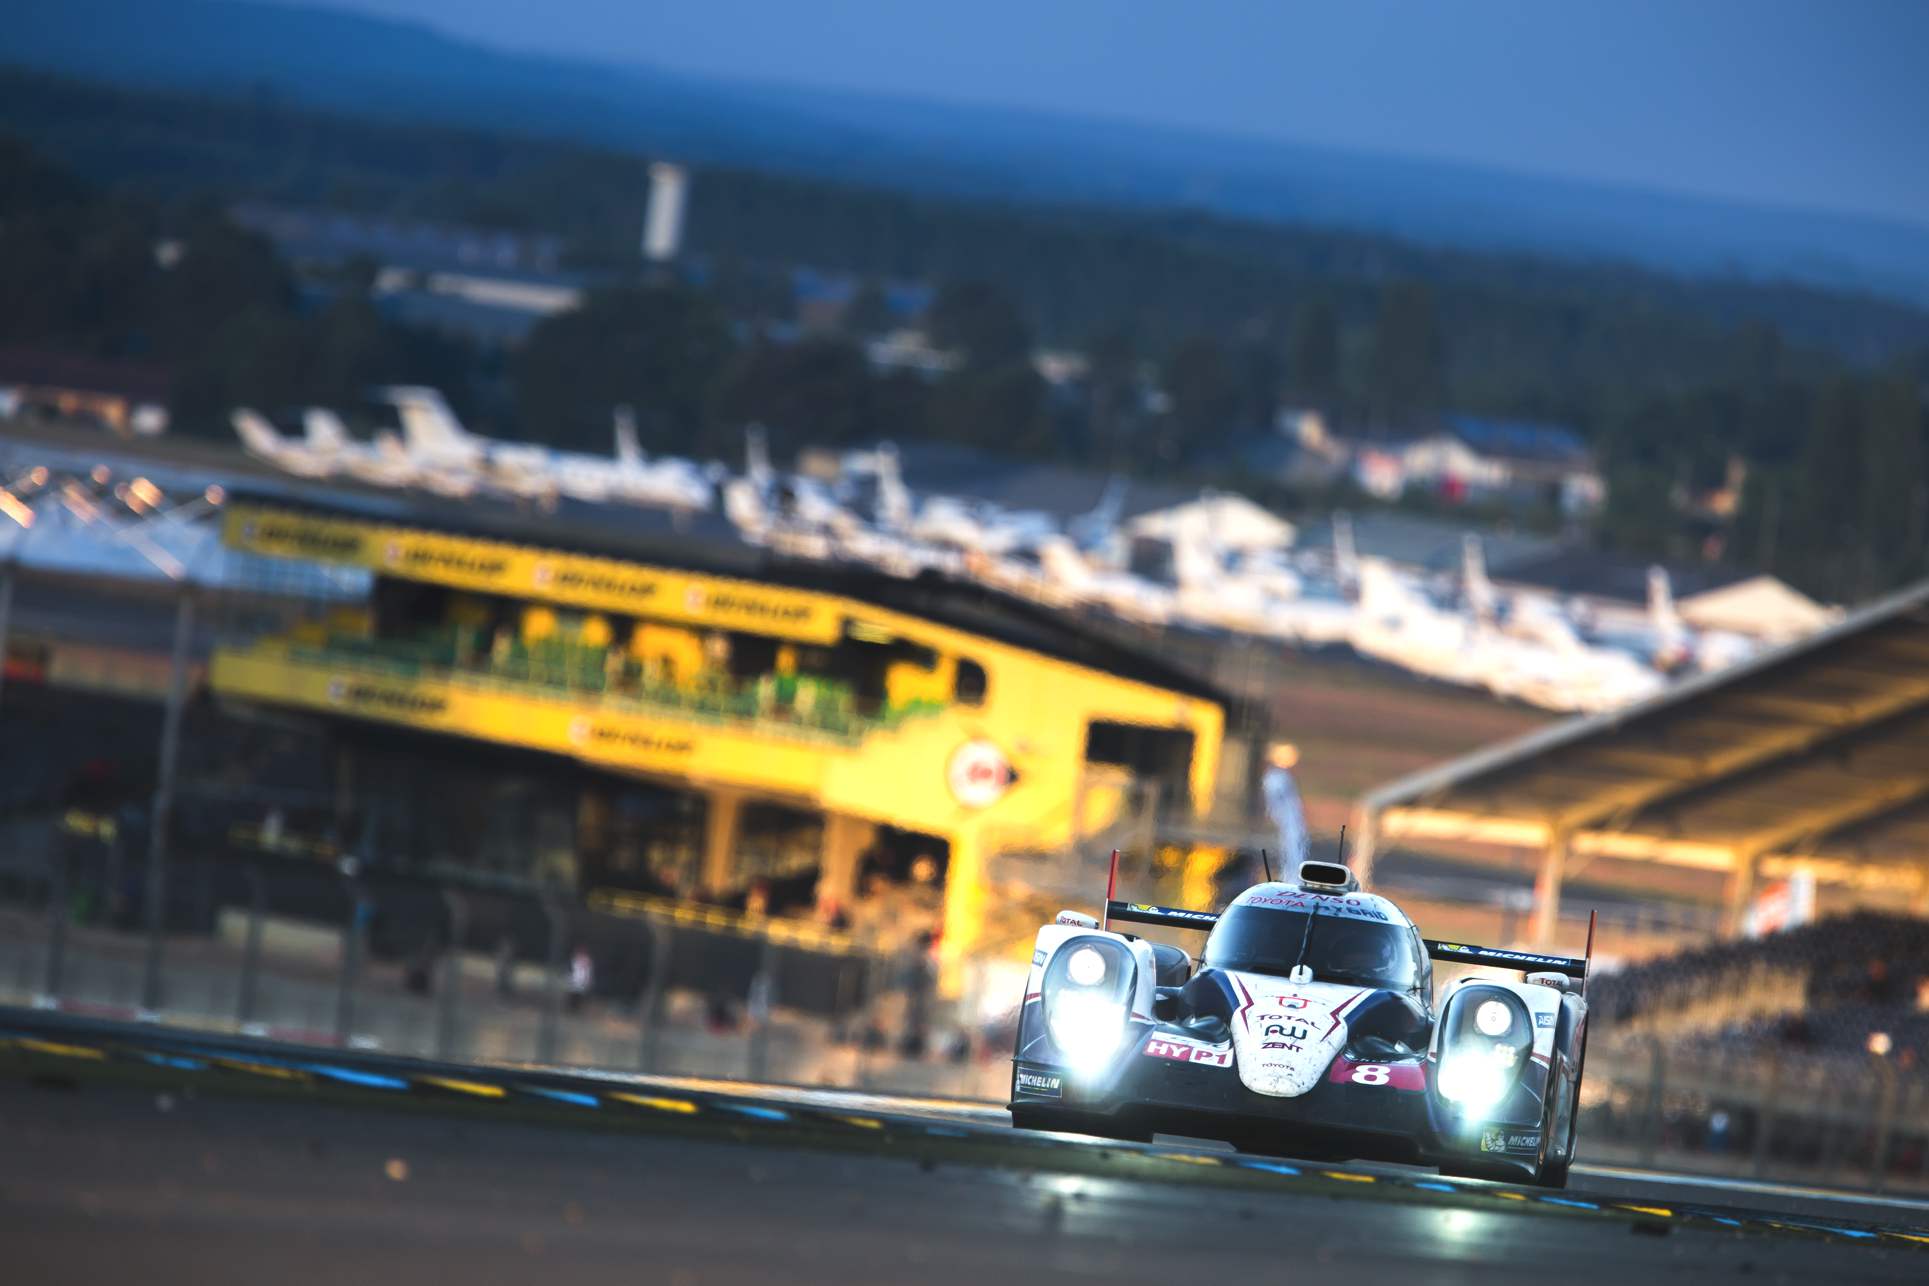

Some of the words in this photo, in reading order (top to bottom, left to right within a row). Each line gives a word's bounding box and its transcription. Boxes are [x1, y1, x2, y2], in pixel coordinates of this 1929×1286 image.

[1249, 896, 1305, 908] TOYOTA
[1276, 890, 1361, 906] DENSO
[1060, 916, 1083, 928] TOTAL
[1478, 950, 1567, 966] MICHELIN
[1540, 977, 1564, 987] TOTAL
[1256, 1014, 1321, 1030] TOTAL
[1260, 1042, 1303, 1053] ZENT
[1262, 1062, 1295, 1072] TOYOTA
[1019, 1073, 1061, 1088] MICHELIN
[1351, 1064, 1390, 1086] 8
